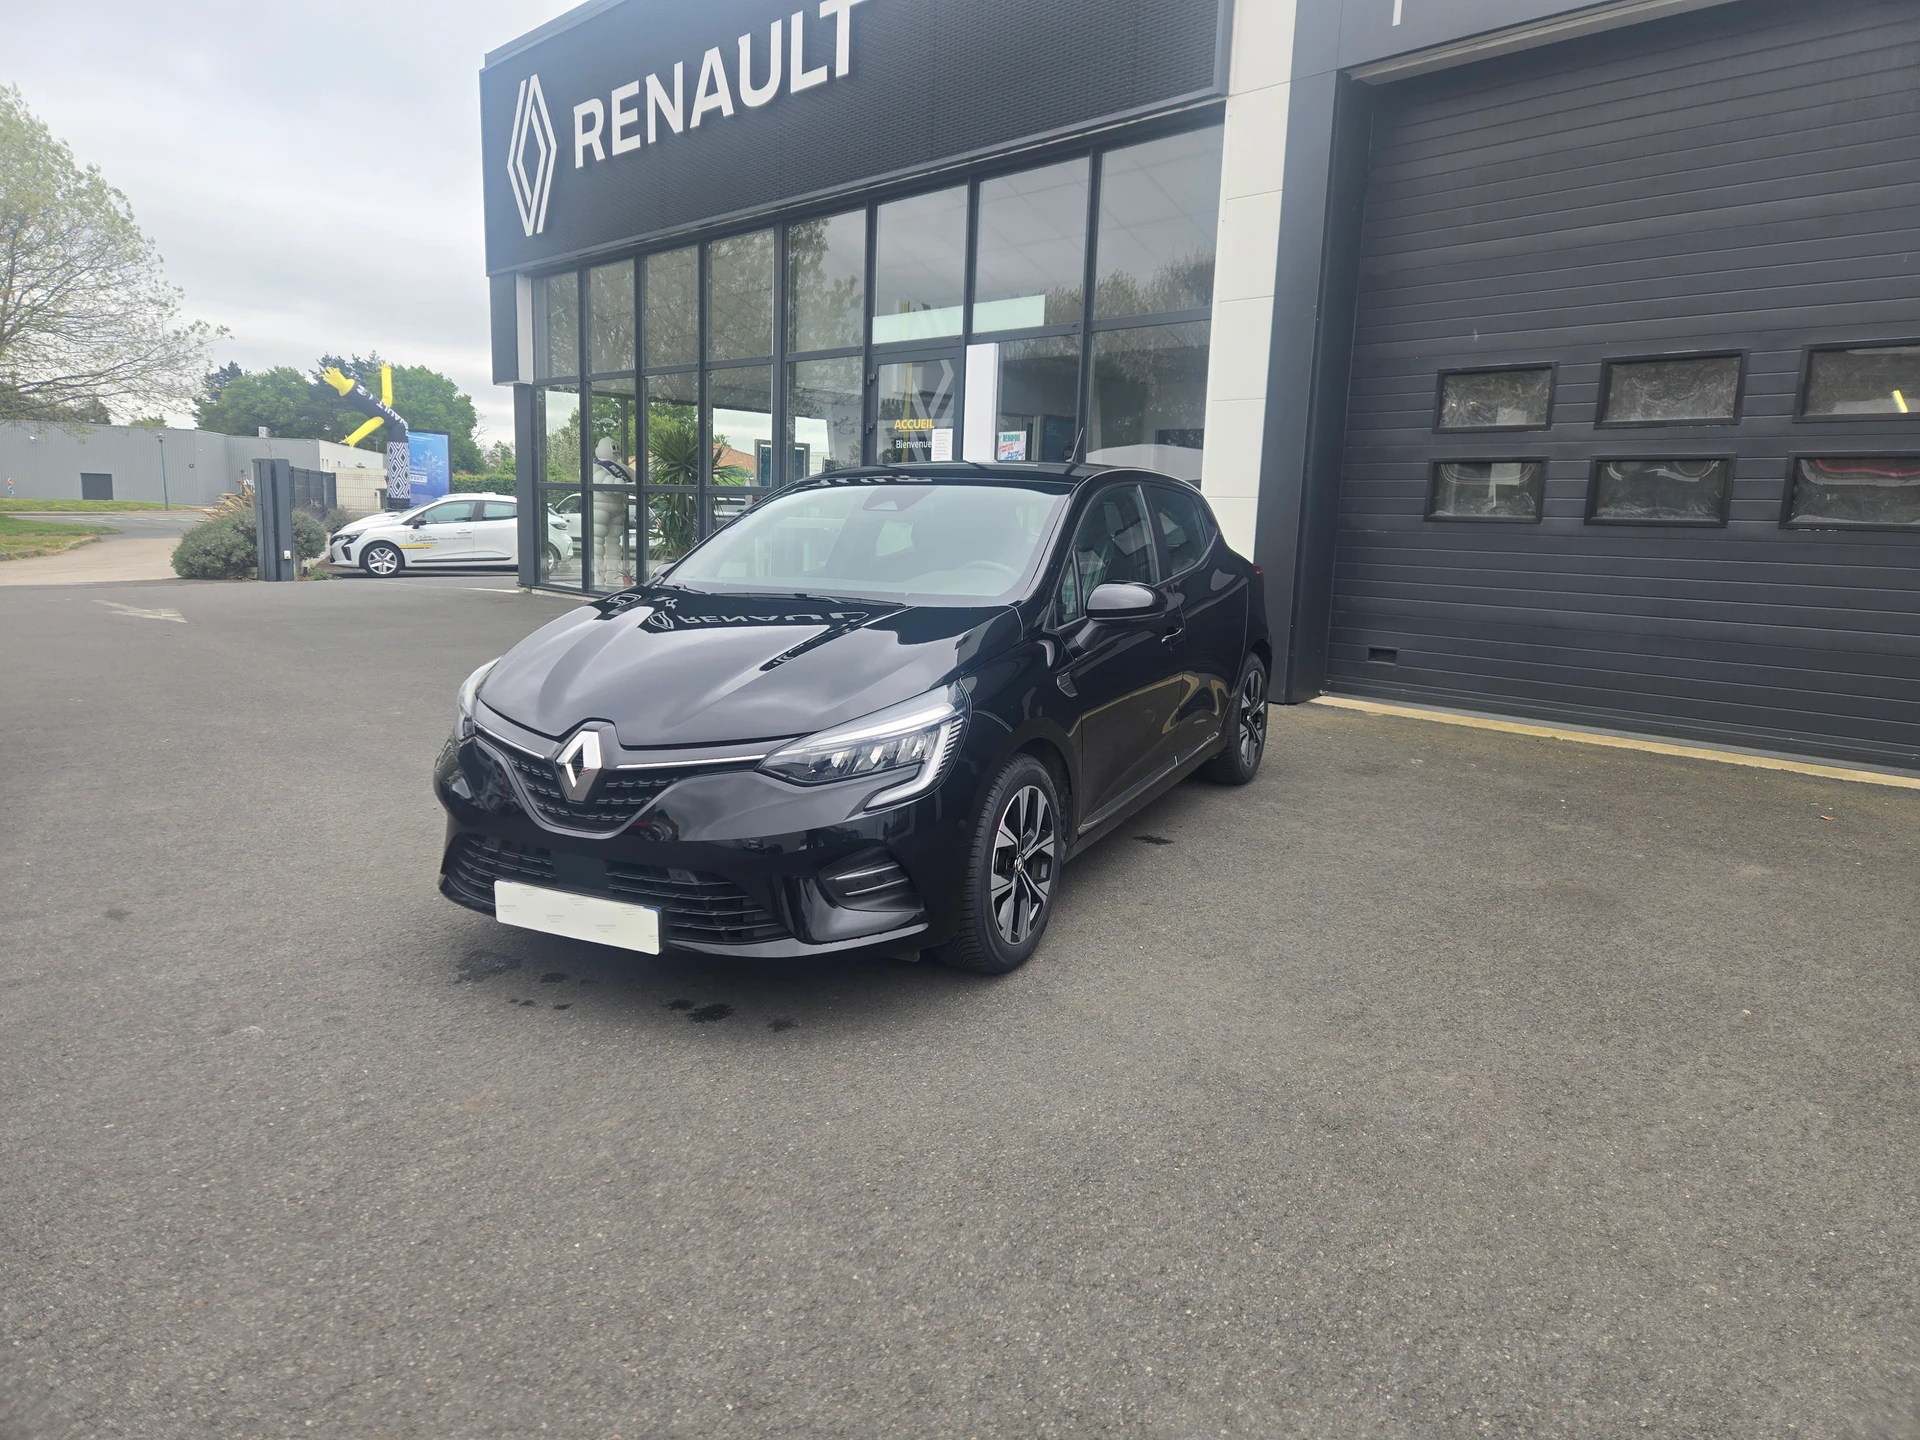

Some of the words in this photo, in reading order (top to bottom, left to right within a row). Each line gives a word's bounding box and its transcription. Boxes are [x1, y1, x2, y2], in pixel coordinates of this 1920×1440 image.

[573, 0, 869, 169] RENAULT
[894, 418, 934, 430] ACCUEIL
[895, 439, 932, 449] Bienvenue
